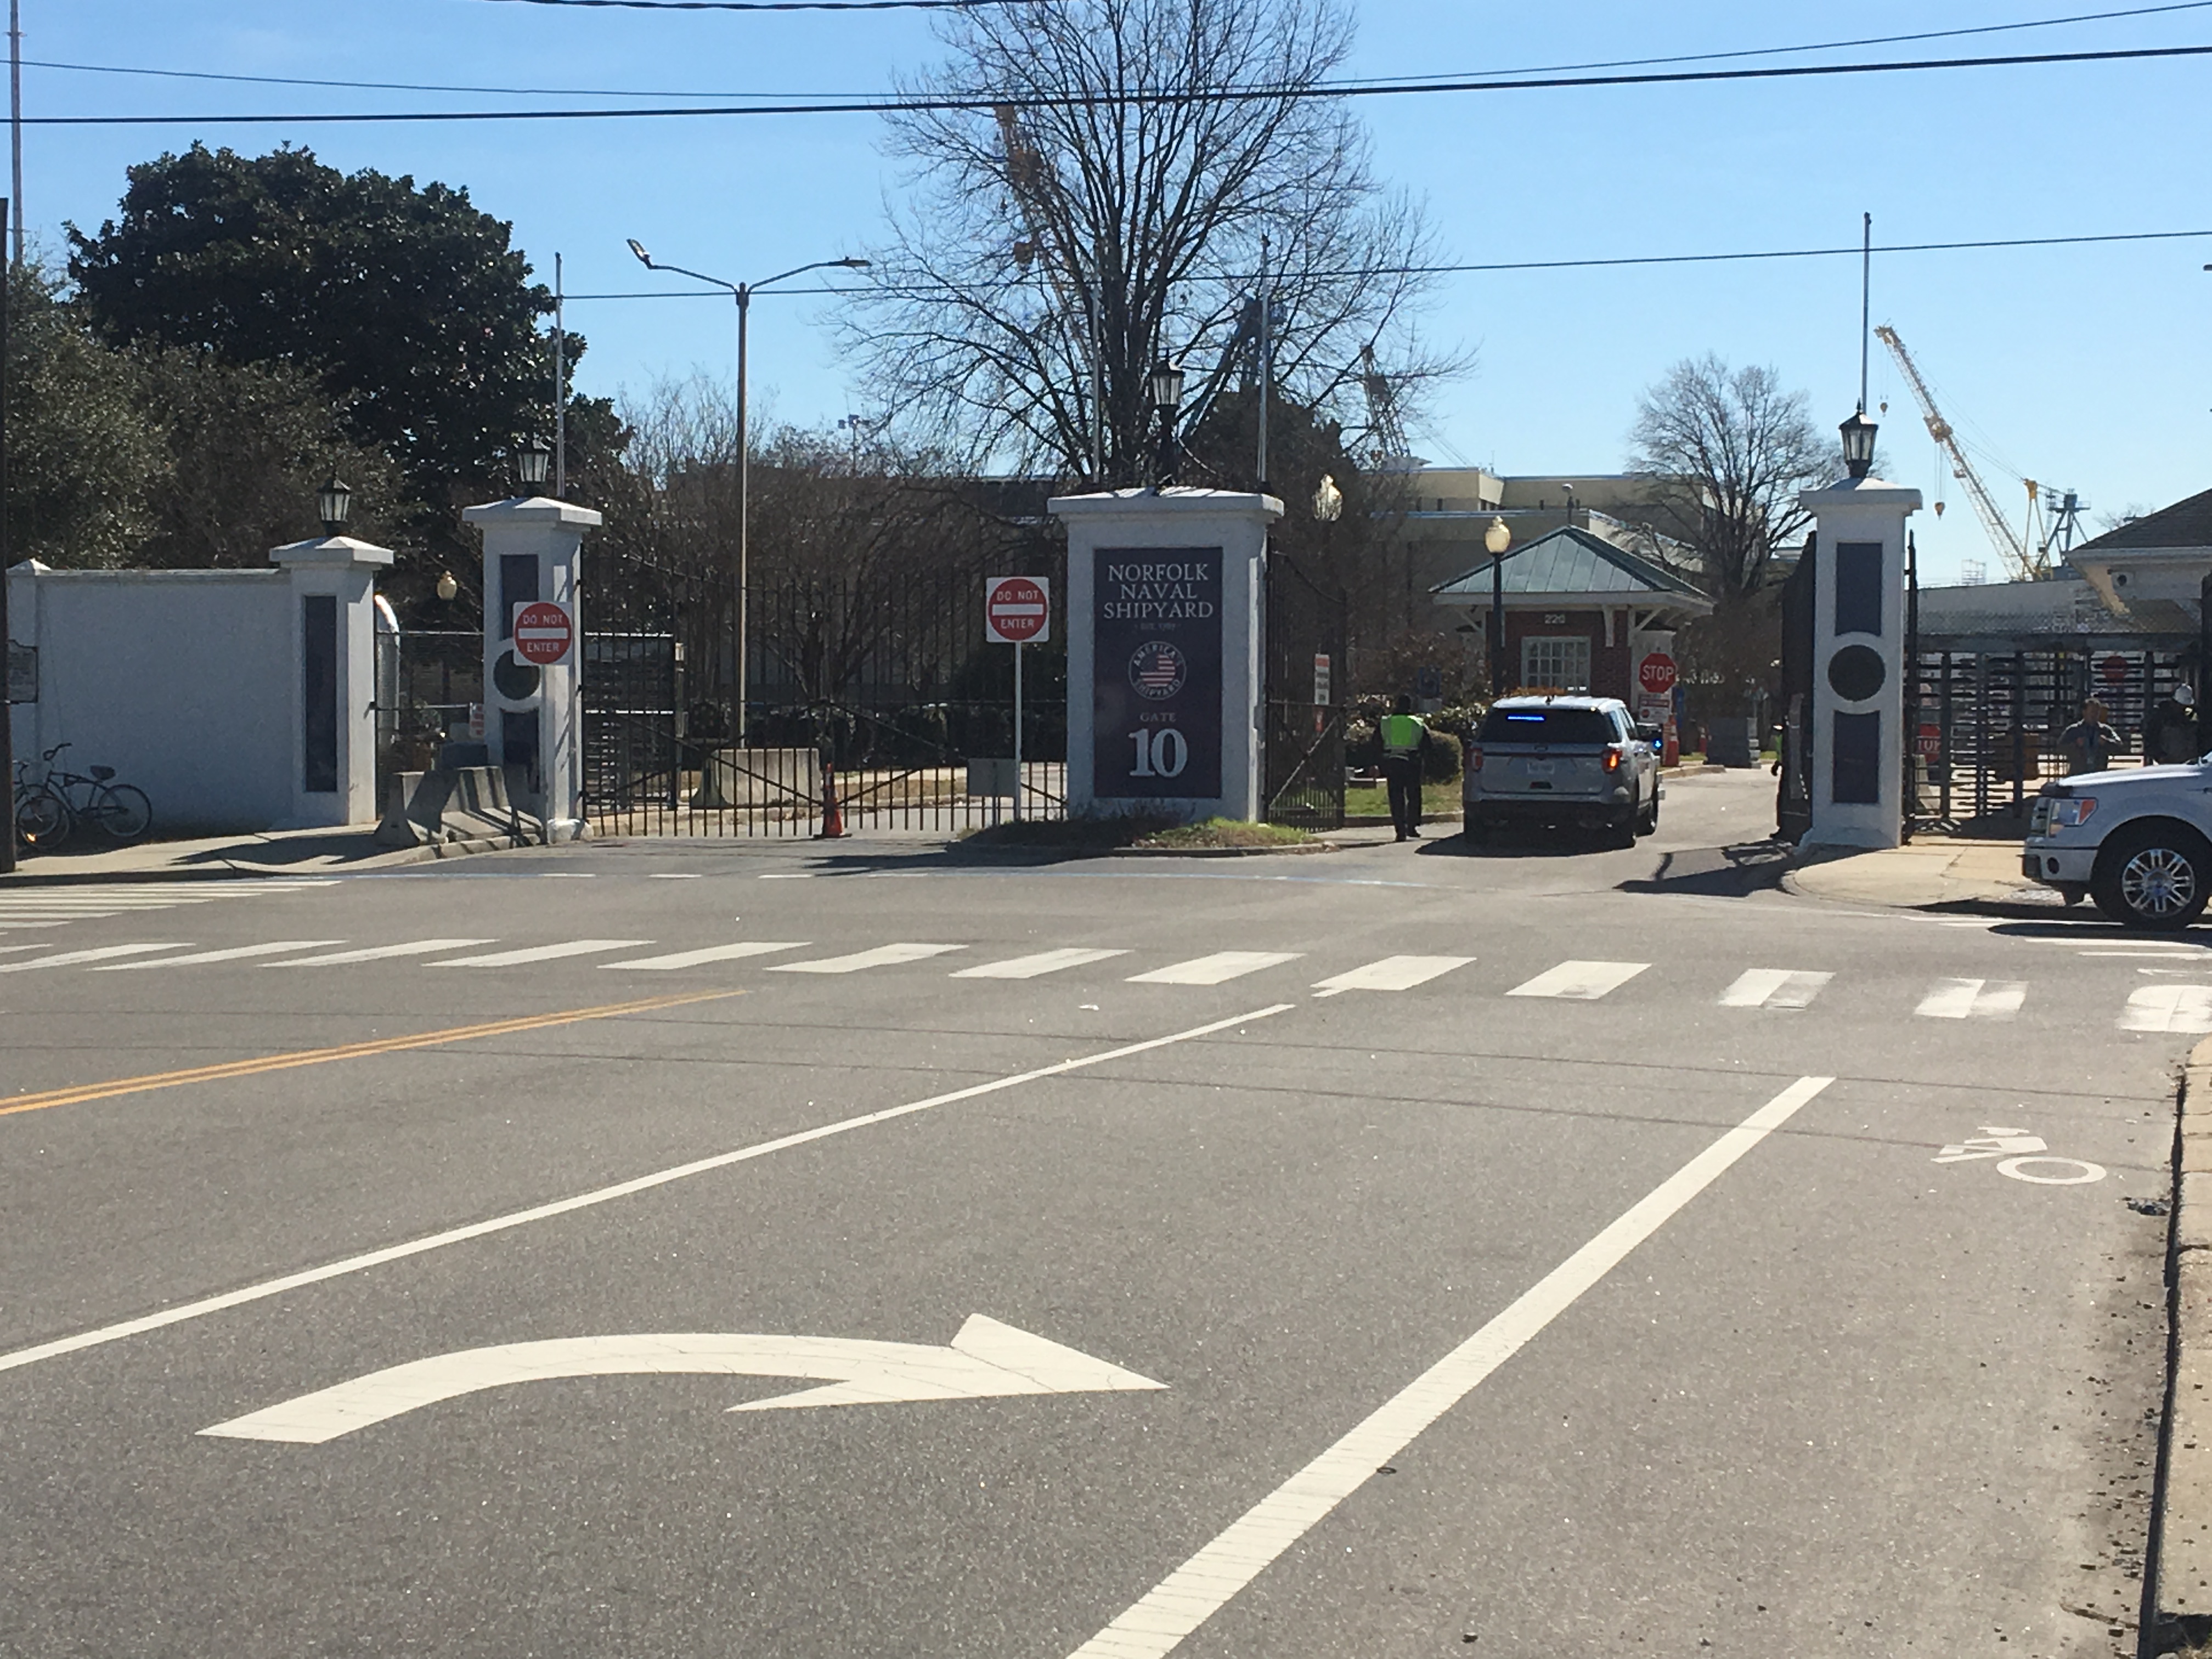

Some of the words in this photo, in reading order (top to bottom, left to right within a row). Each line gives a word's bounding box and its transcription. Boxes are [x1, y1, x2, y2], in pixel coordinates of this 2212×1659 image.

[1108, 563, 1209, 582] NORFOLK
[996, 591, 1012, 601] DO
[1018, 590, 1039, 601] NOT
[1120, 583, 1198, 599] NAVAL
[1103, 602, 1214, 619] SHIPYARD
[523, 614, 537, 624] DO
[543, 614, 563, 625] NOT
[1000, 618, 1035, 630] ENTER
[527, 642, 560, 652] ENTER
[1642, 664, 1674, 681] STOP
[1139, 712, 1177, 723] GATE
[1128, 728, 1188, 777] 10
